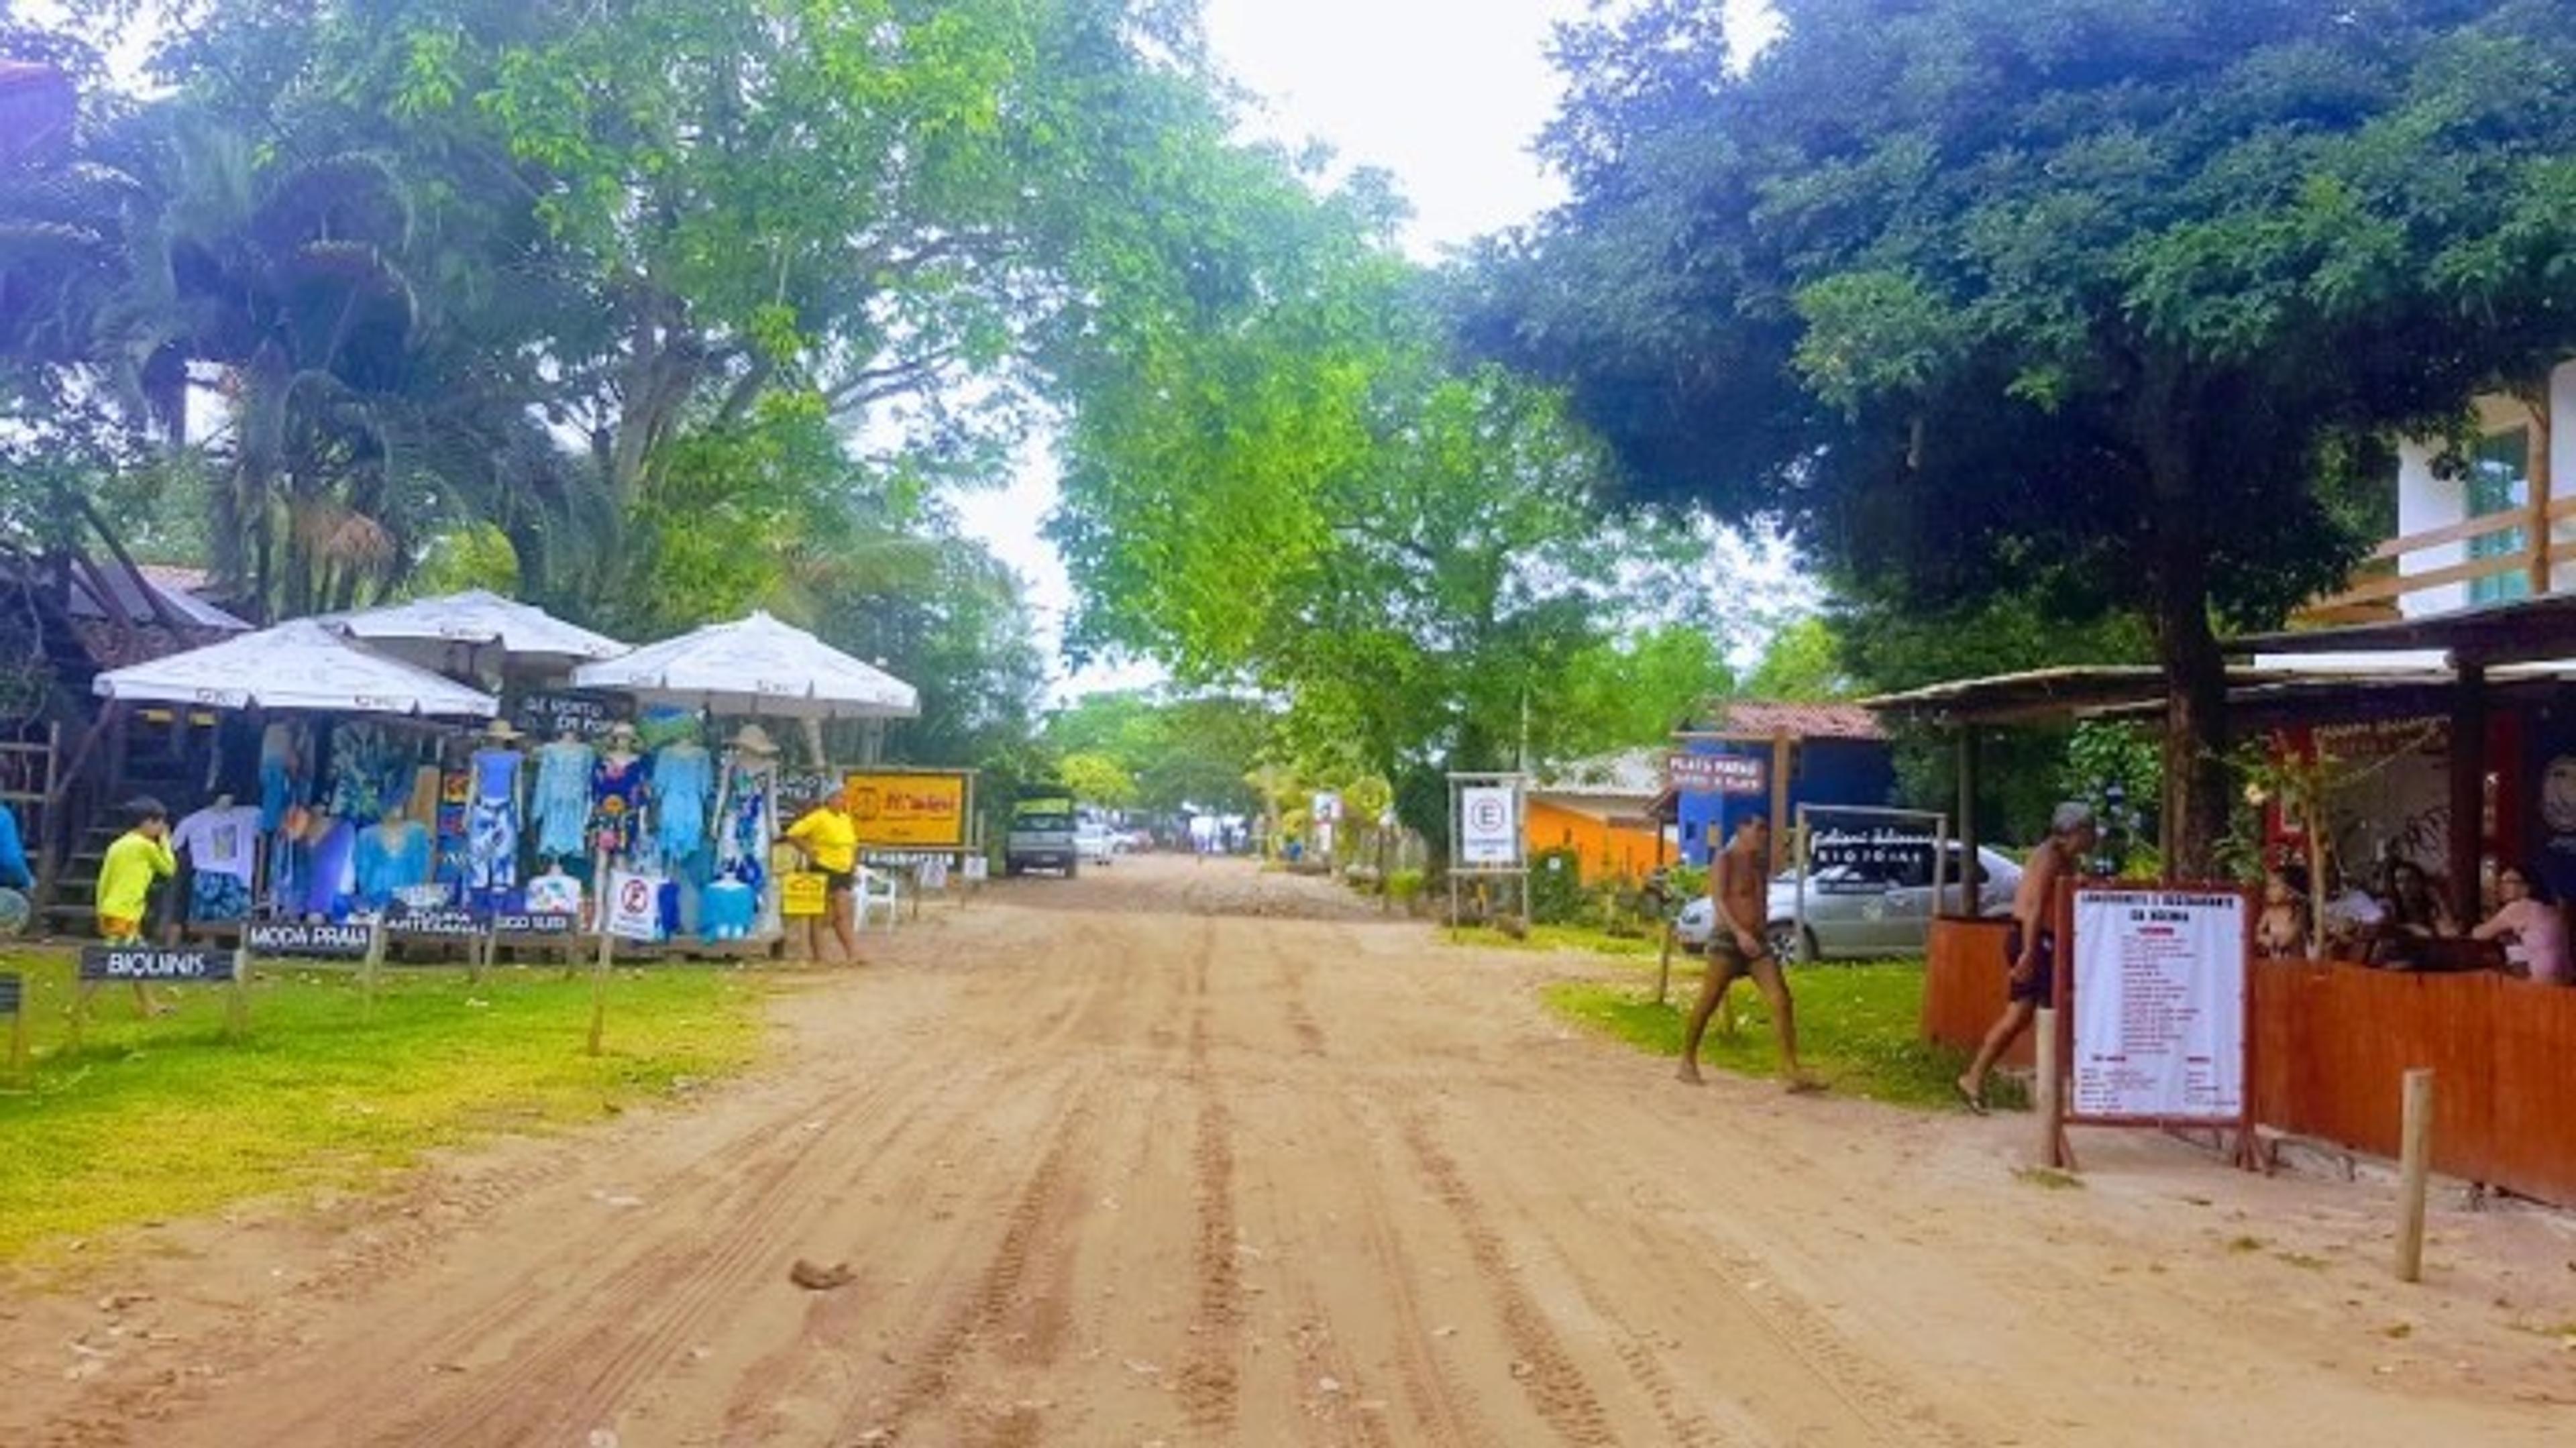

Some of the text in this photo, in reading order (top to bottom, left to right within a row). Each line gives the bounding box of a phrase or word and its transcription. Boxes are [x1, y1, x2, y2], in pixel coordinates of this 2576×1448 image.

[1481, 805, 1495, 825] E
[250, 926, 307, 946] MODA
[107, 952, 205, 976] BIQUINIS
